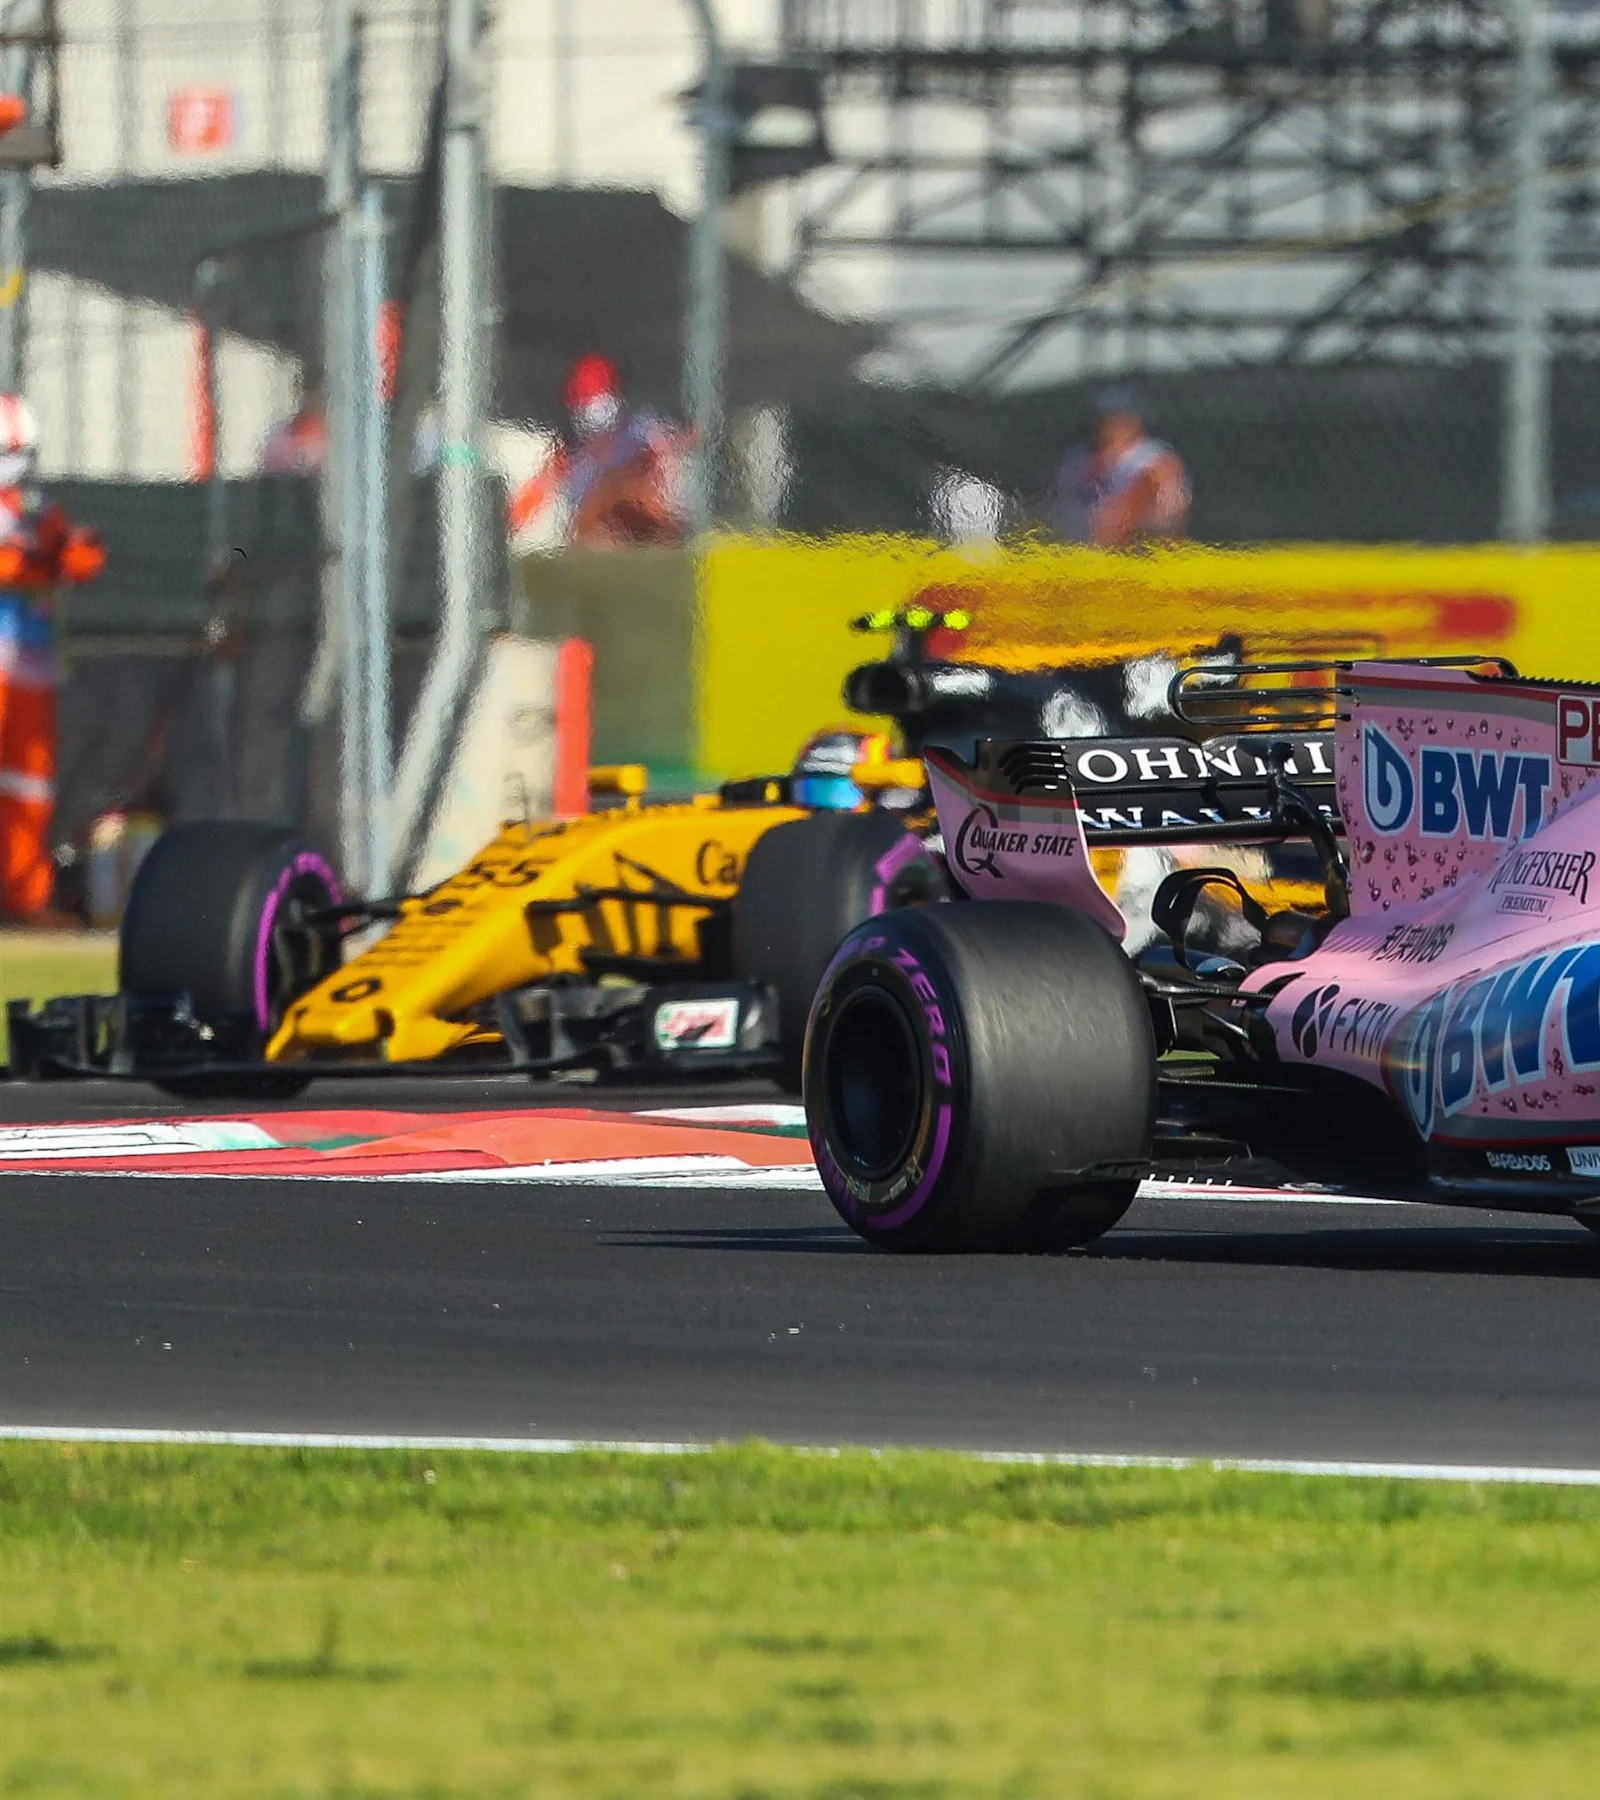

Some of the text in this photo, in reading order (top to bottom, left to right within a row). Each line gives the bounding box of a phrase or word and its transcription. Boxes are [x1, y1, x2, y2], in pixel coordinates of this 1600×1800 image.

[1418, 748, 1552, 842] BWT
[970, 825, 1078, 857] QUAKER STATE
[1329, 997, 1398, 1061] FXTM
